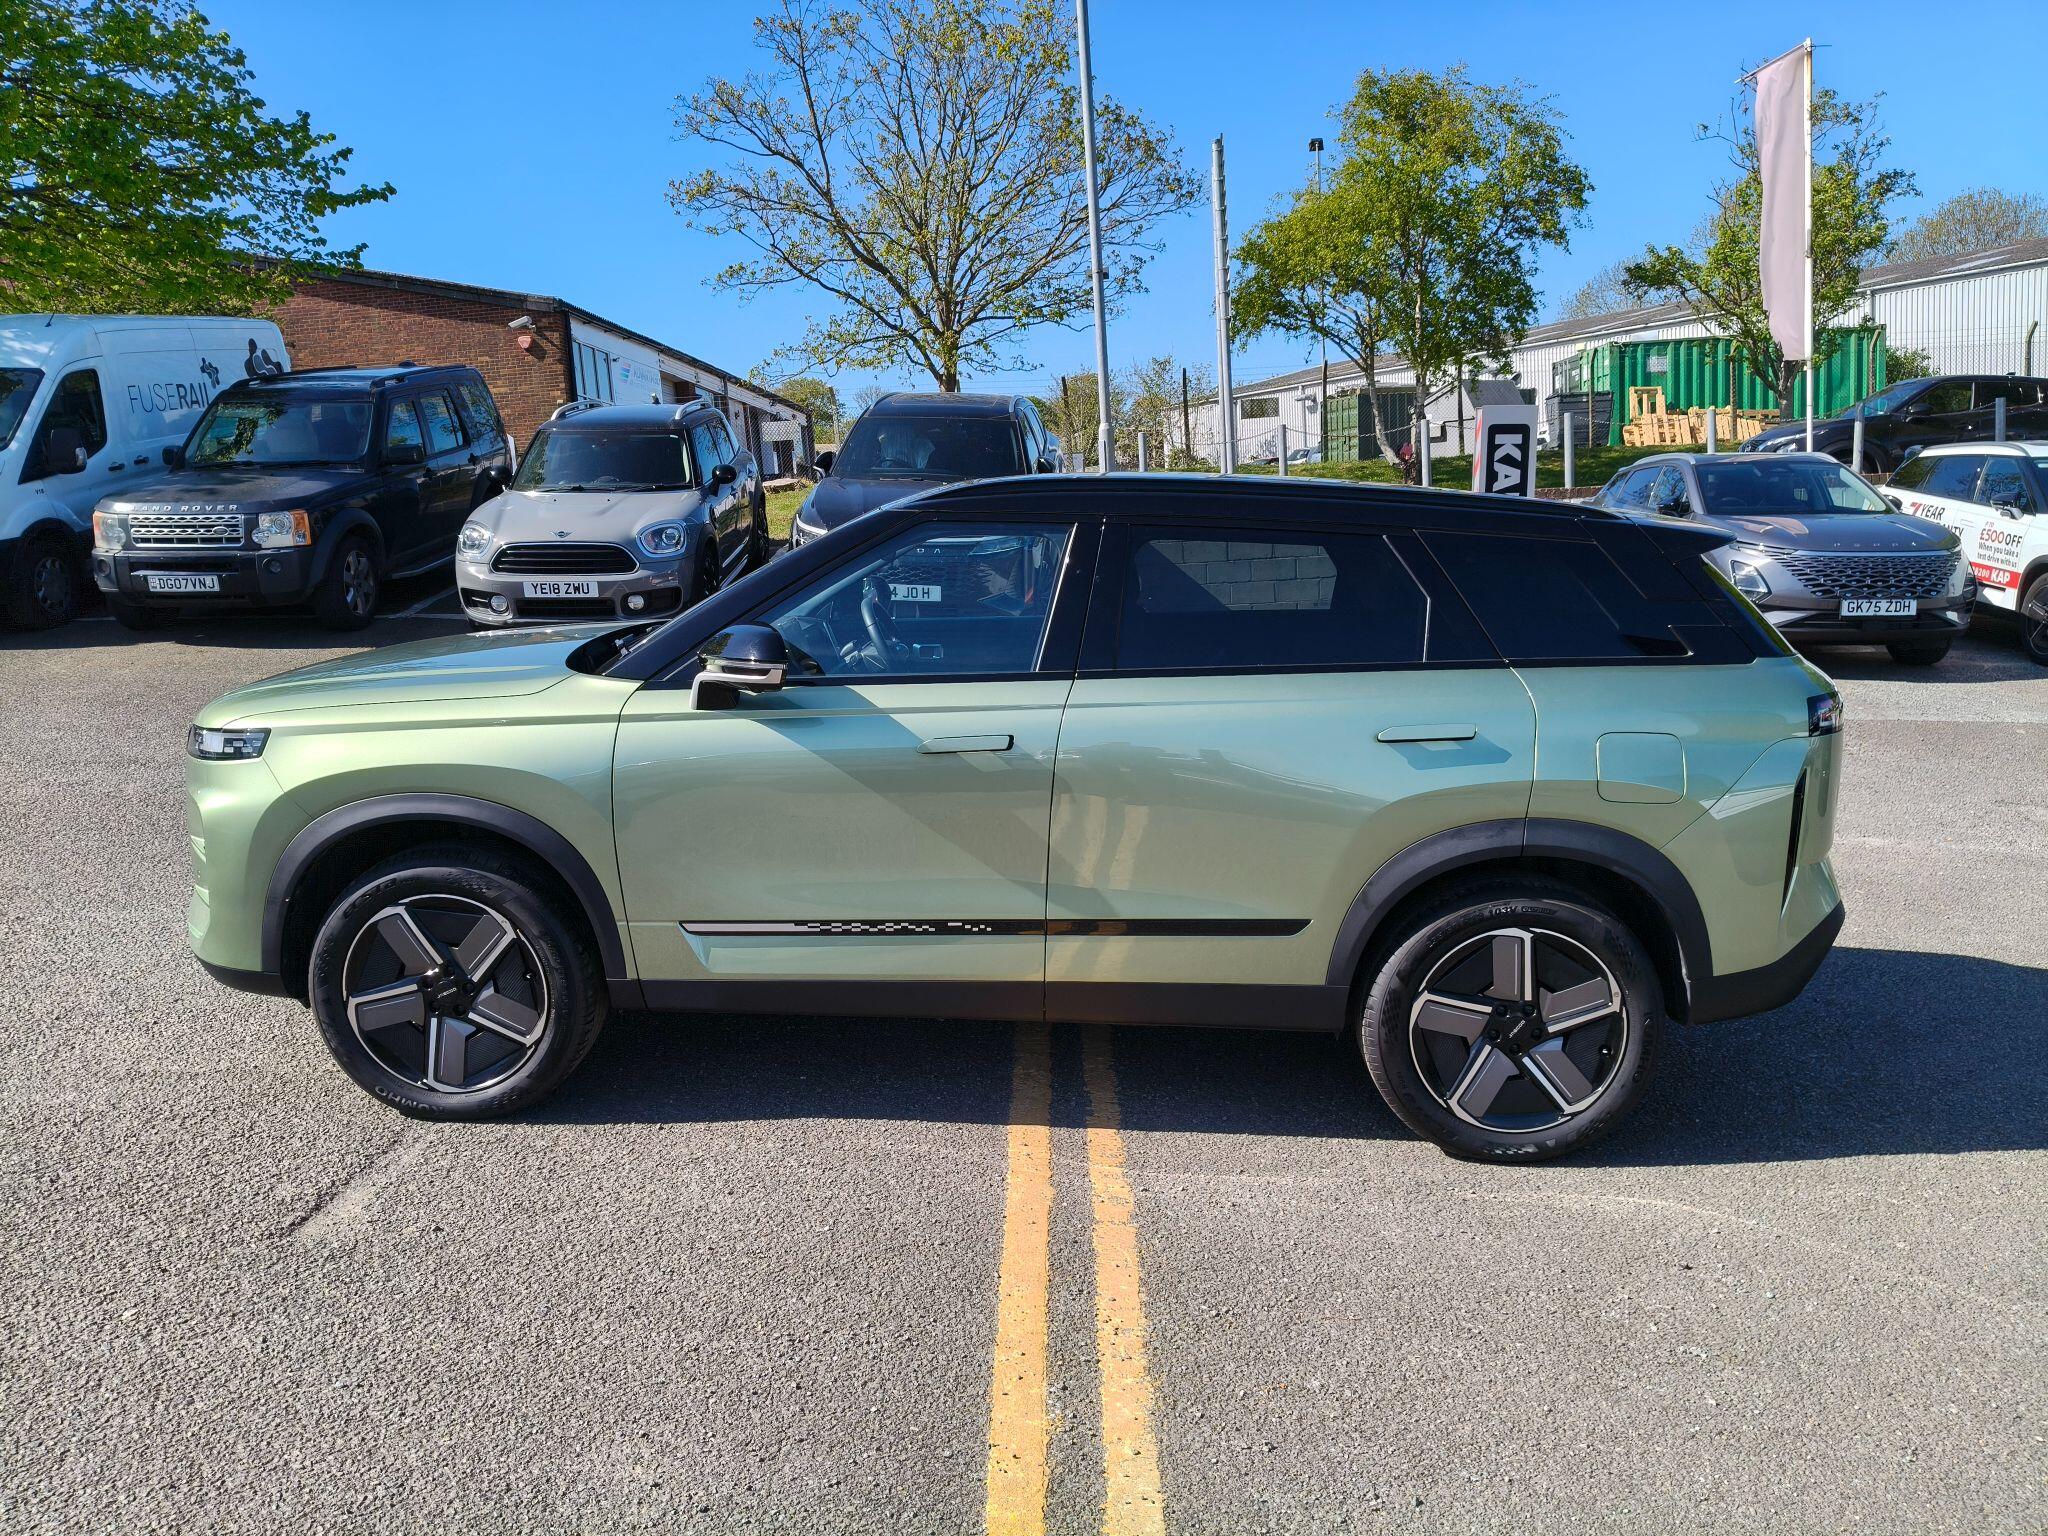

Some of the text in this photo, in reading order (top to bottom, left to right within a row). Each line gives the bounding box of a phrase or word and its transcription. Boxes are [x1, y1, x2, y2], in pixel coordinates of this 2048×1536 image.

[1493, 433, 1523, 496] KA
[181, 504, 238, 512] ROVER
[1920, 503, 1945, 521] YEAR
[1979, 528, 2005, 544] £500
[2005, 533, 2023, 548] OFF
[1978, 541, 1993, 552] When
[1993, 546, 2003, 557] you
[2003, 547, 2015, 558] take
[1987, 553, 1999, 564] drive
[157, 577, 216, 590] DG07VNJ
[1990, 568, 2011, 584] KAP
[531, 582, 590, 595] YE18 ZWU
[1847, 600, 1911, 614] GK75 ZDH
